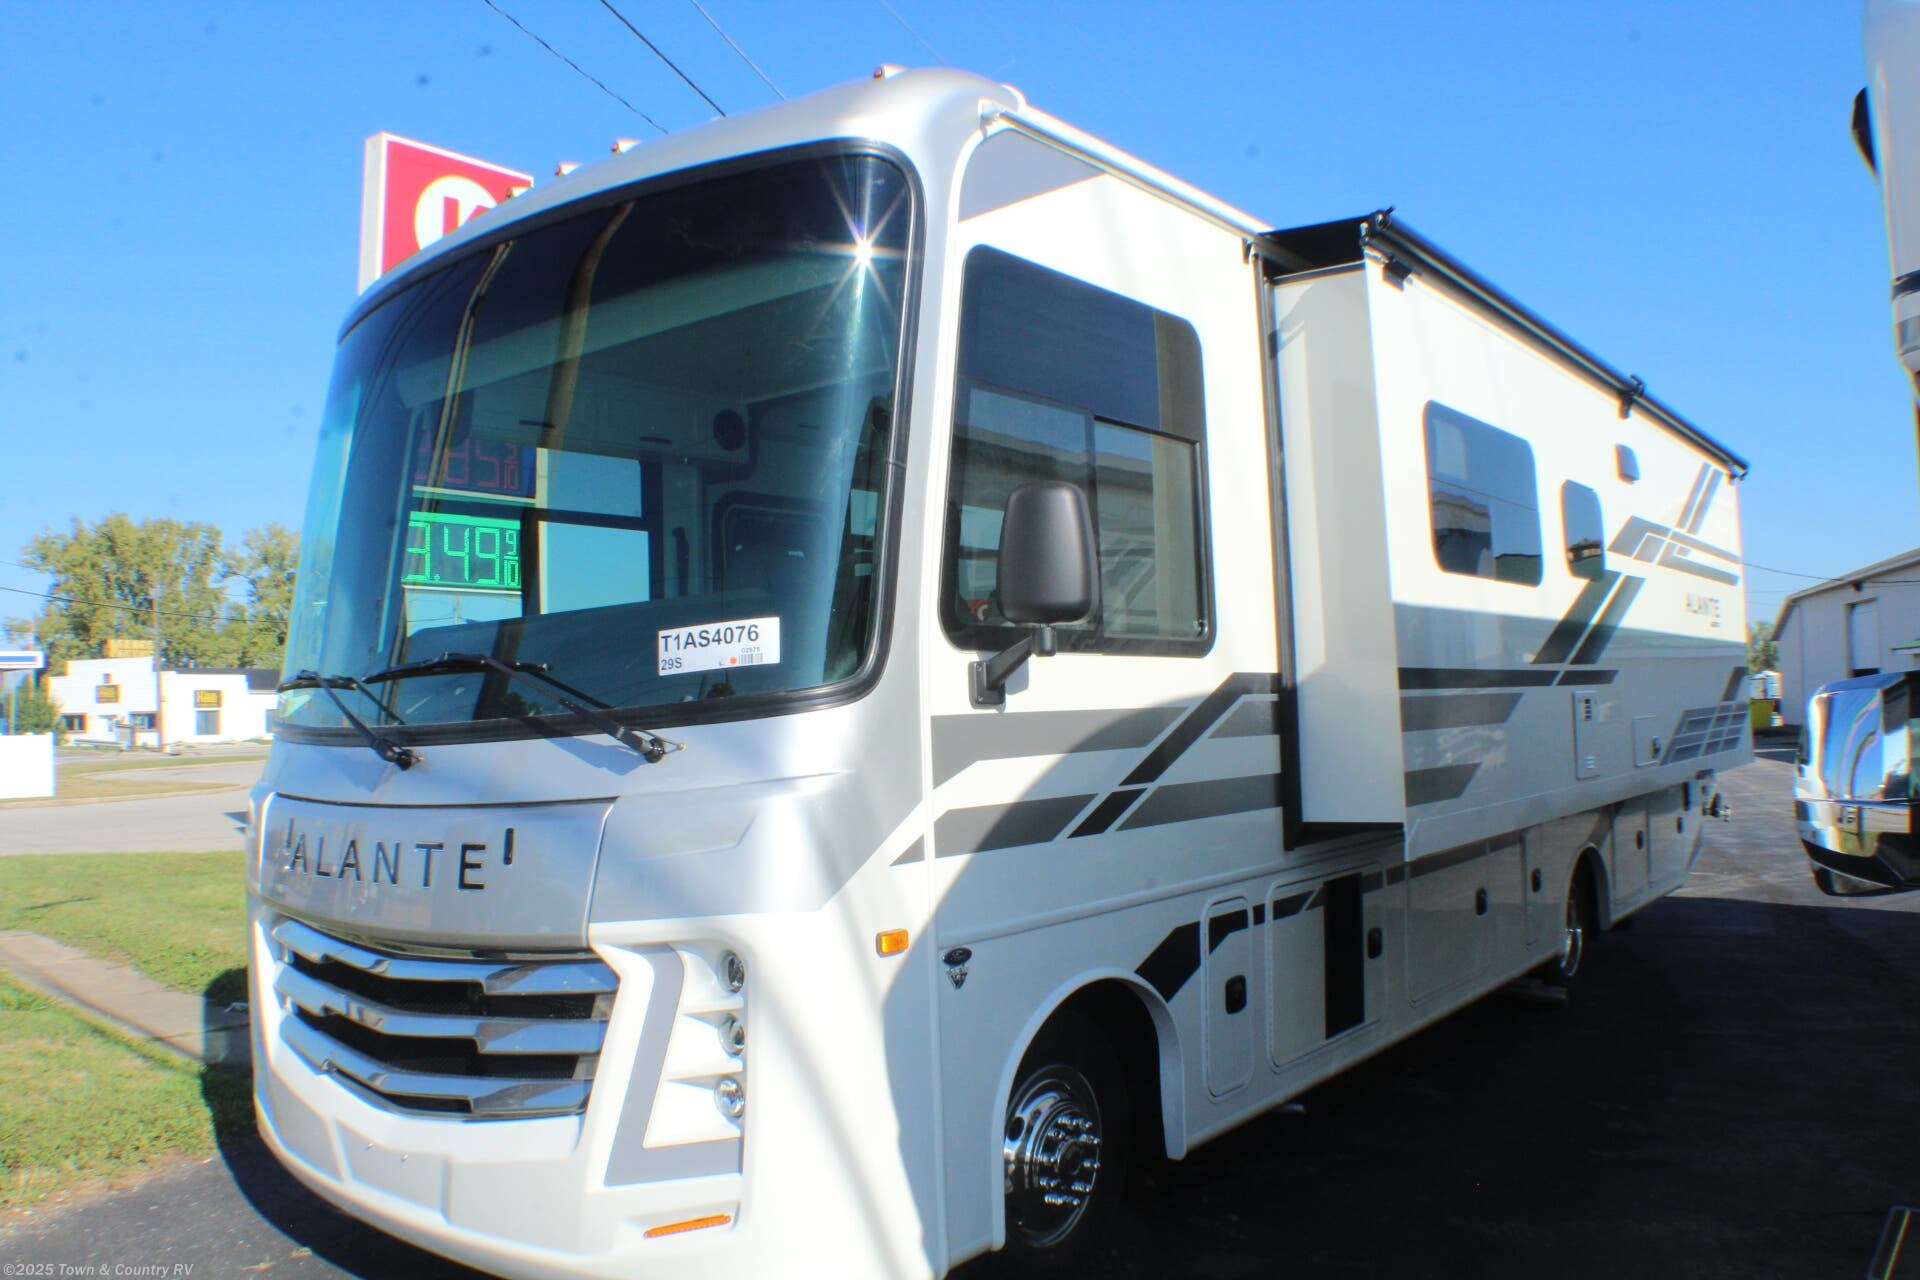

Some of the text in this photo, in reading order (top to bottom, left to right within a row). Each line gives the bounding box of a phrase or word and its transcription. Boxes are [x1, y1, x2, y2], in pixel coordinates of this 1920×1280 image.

[660, 624, 759, 652] T1AS4076
[660, 658, 682, 670] 29S
[289, 833, 488, 890] ALANTE
